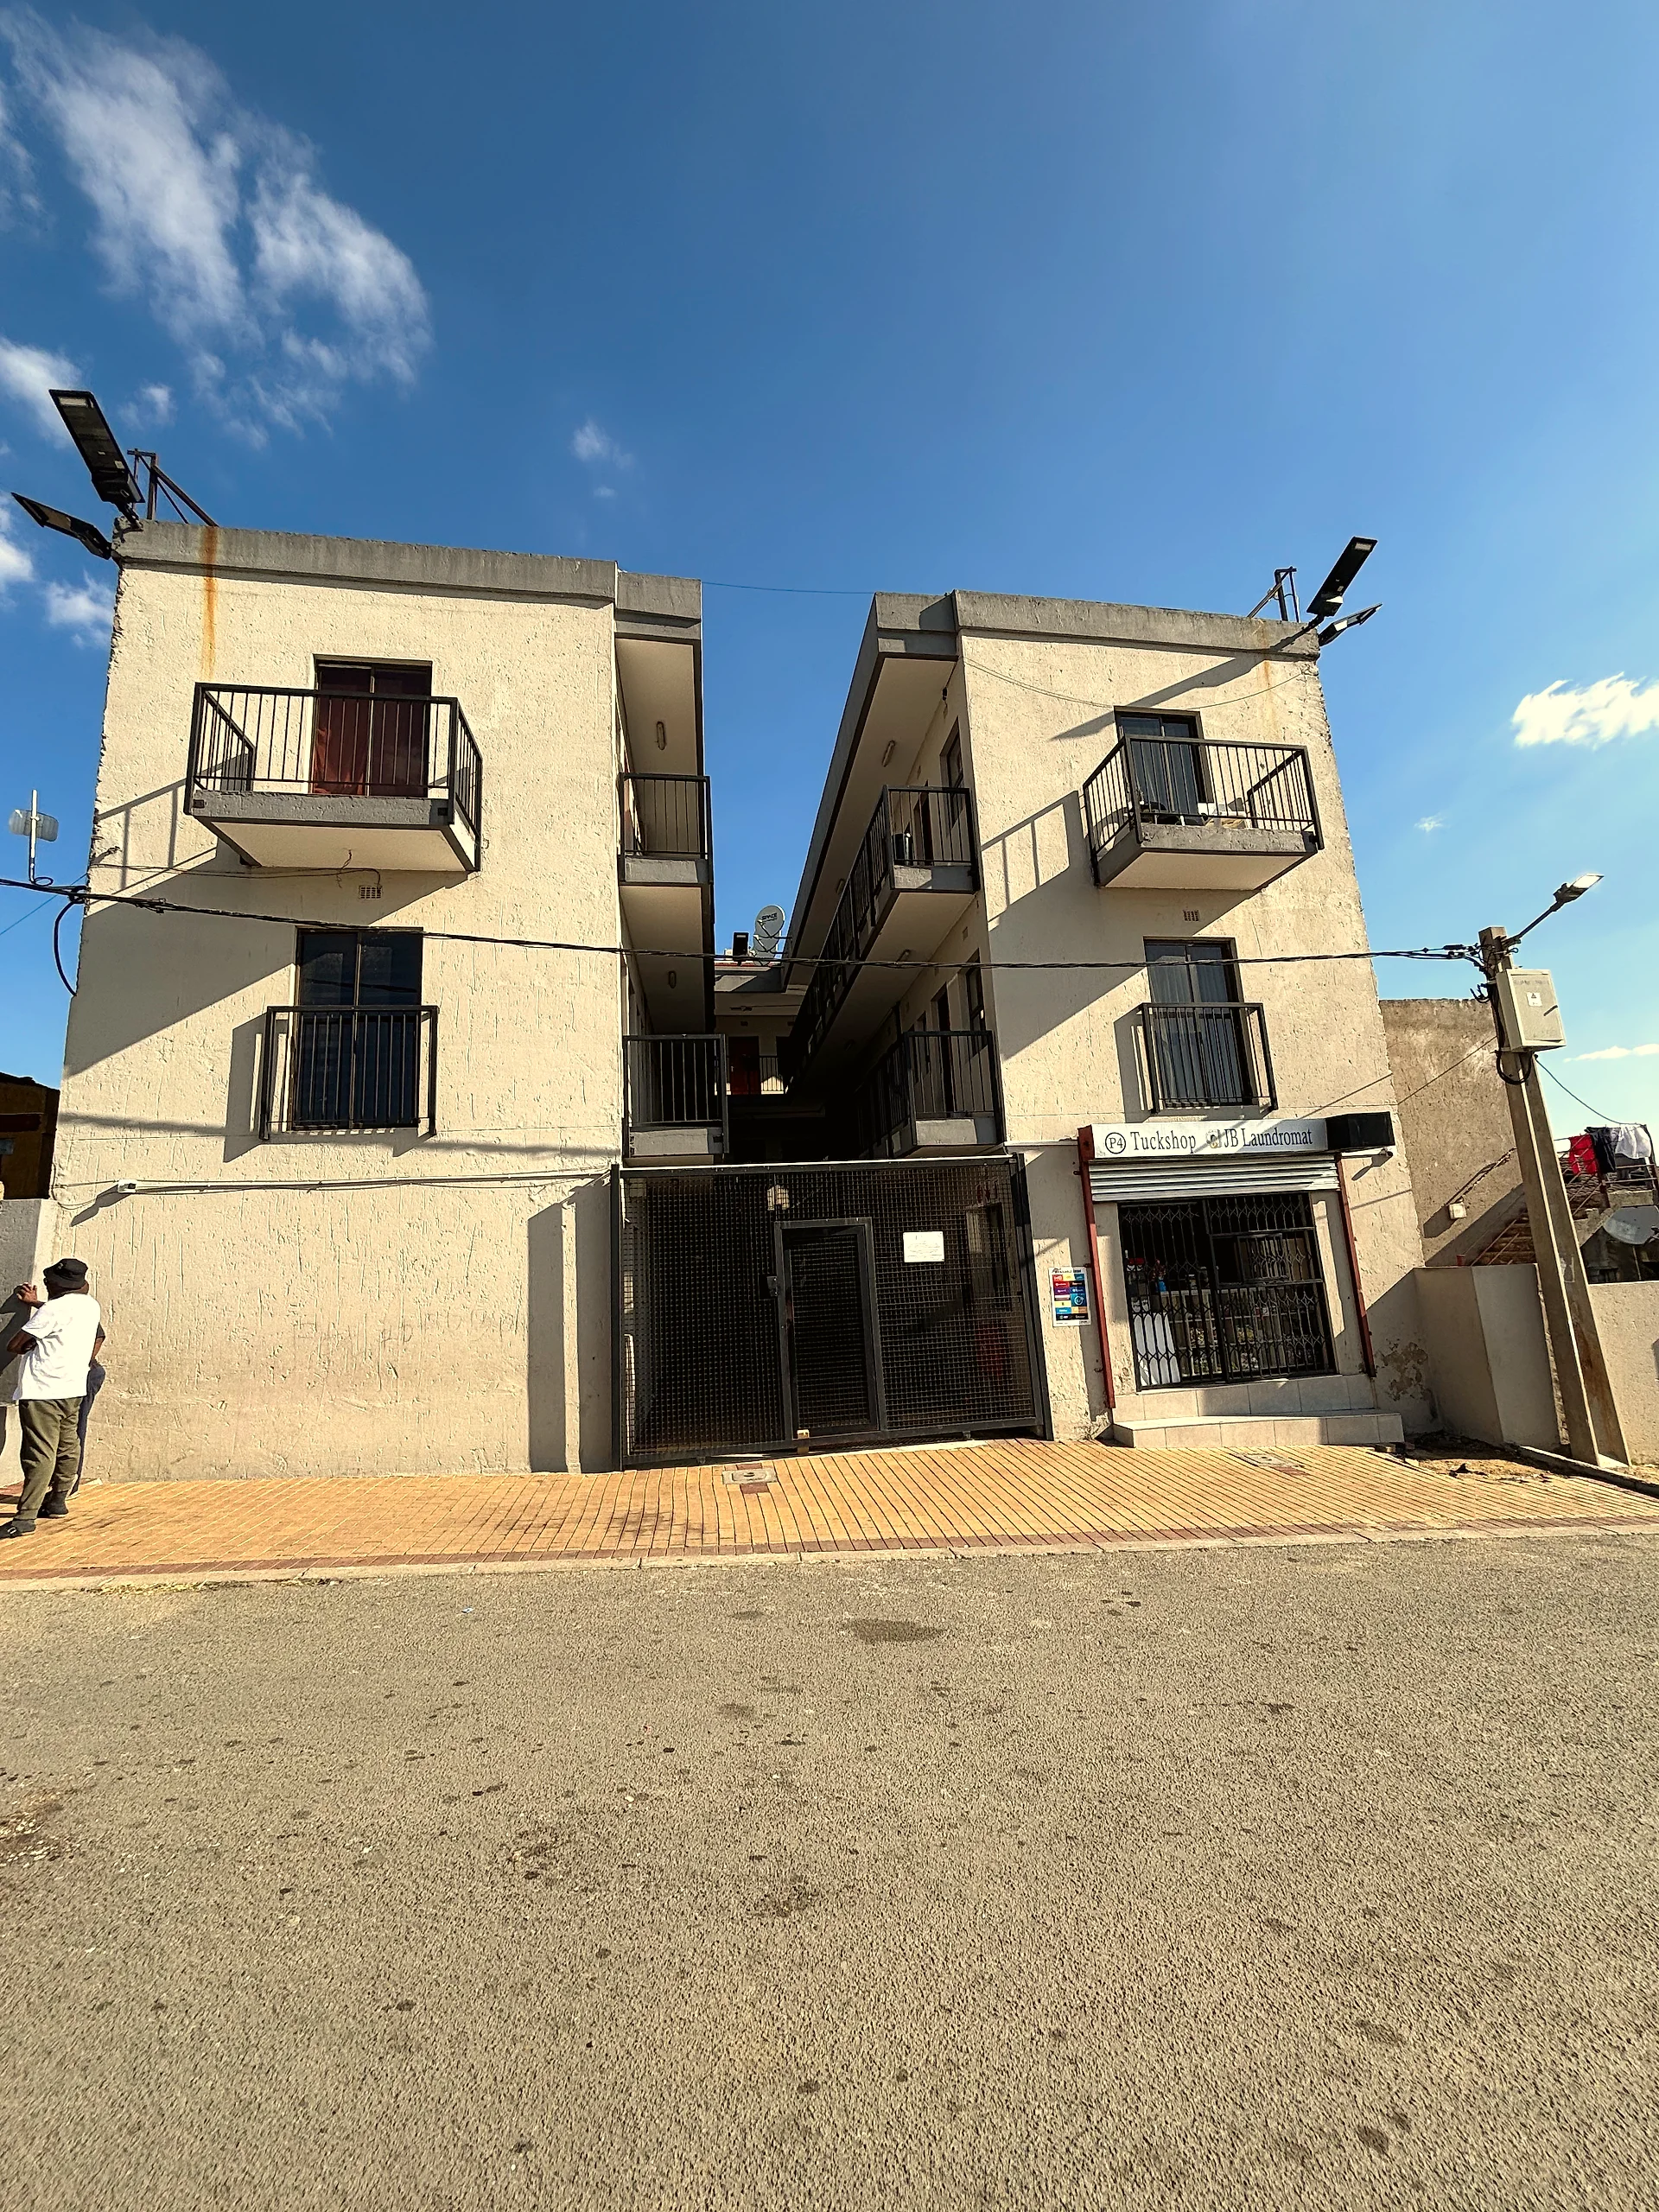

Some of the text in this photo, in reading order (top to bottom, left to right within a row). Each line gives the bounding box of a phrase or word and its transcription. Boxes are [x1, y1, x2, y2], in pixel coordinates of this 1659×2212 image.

[1109, 1127, 1313, 1154] P4 Tuckshop JB Laundromat
